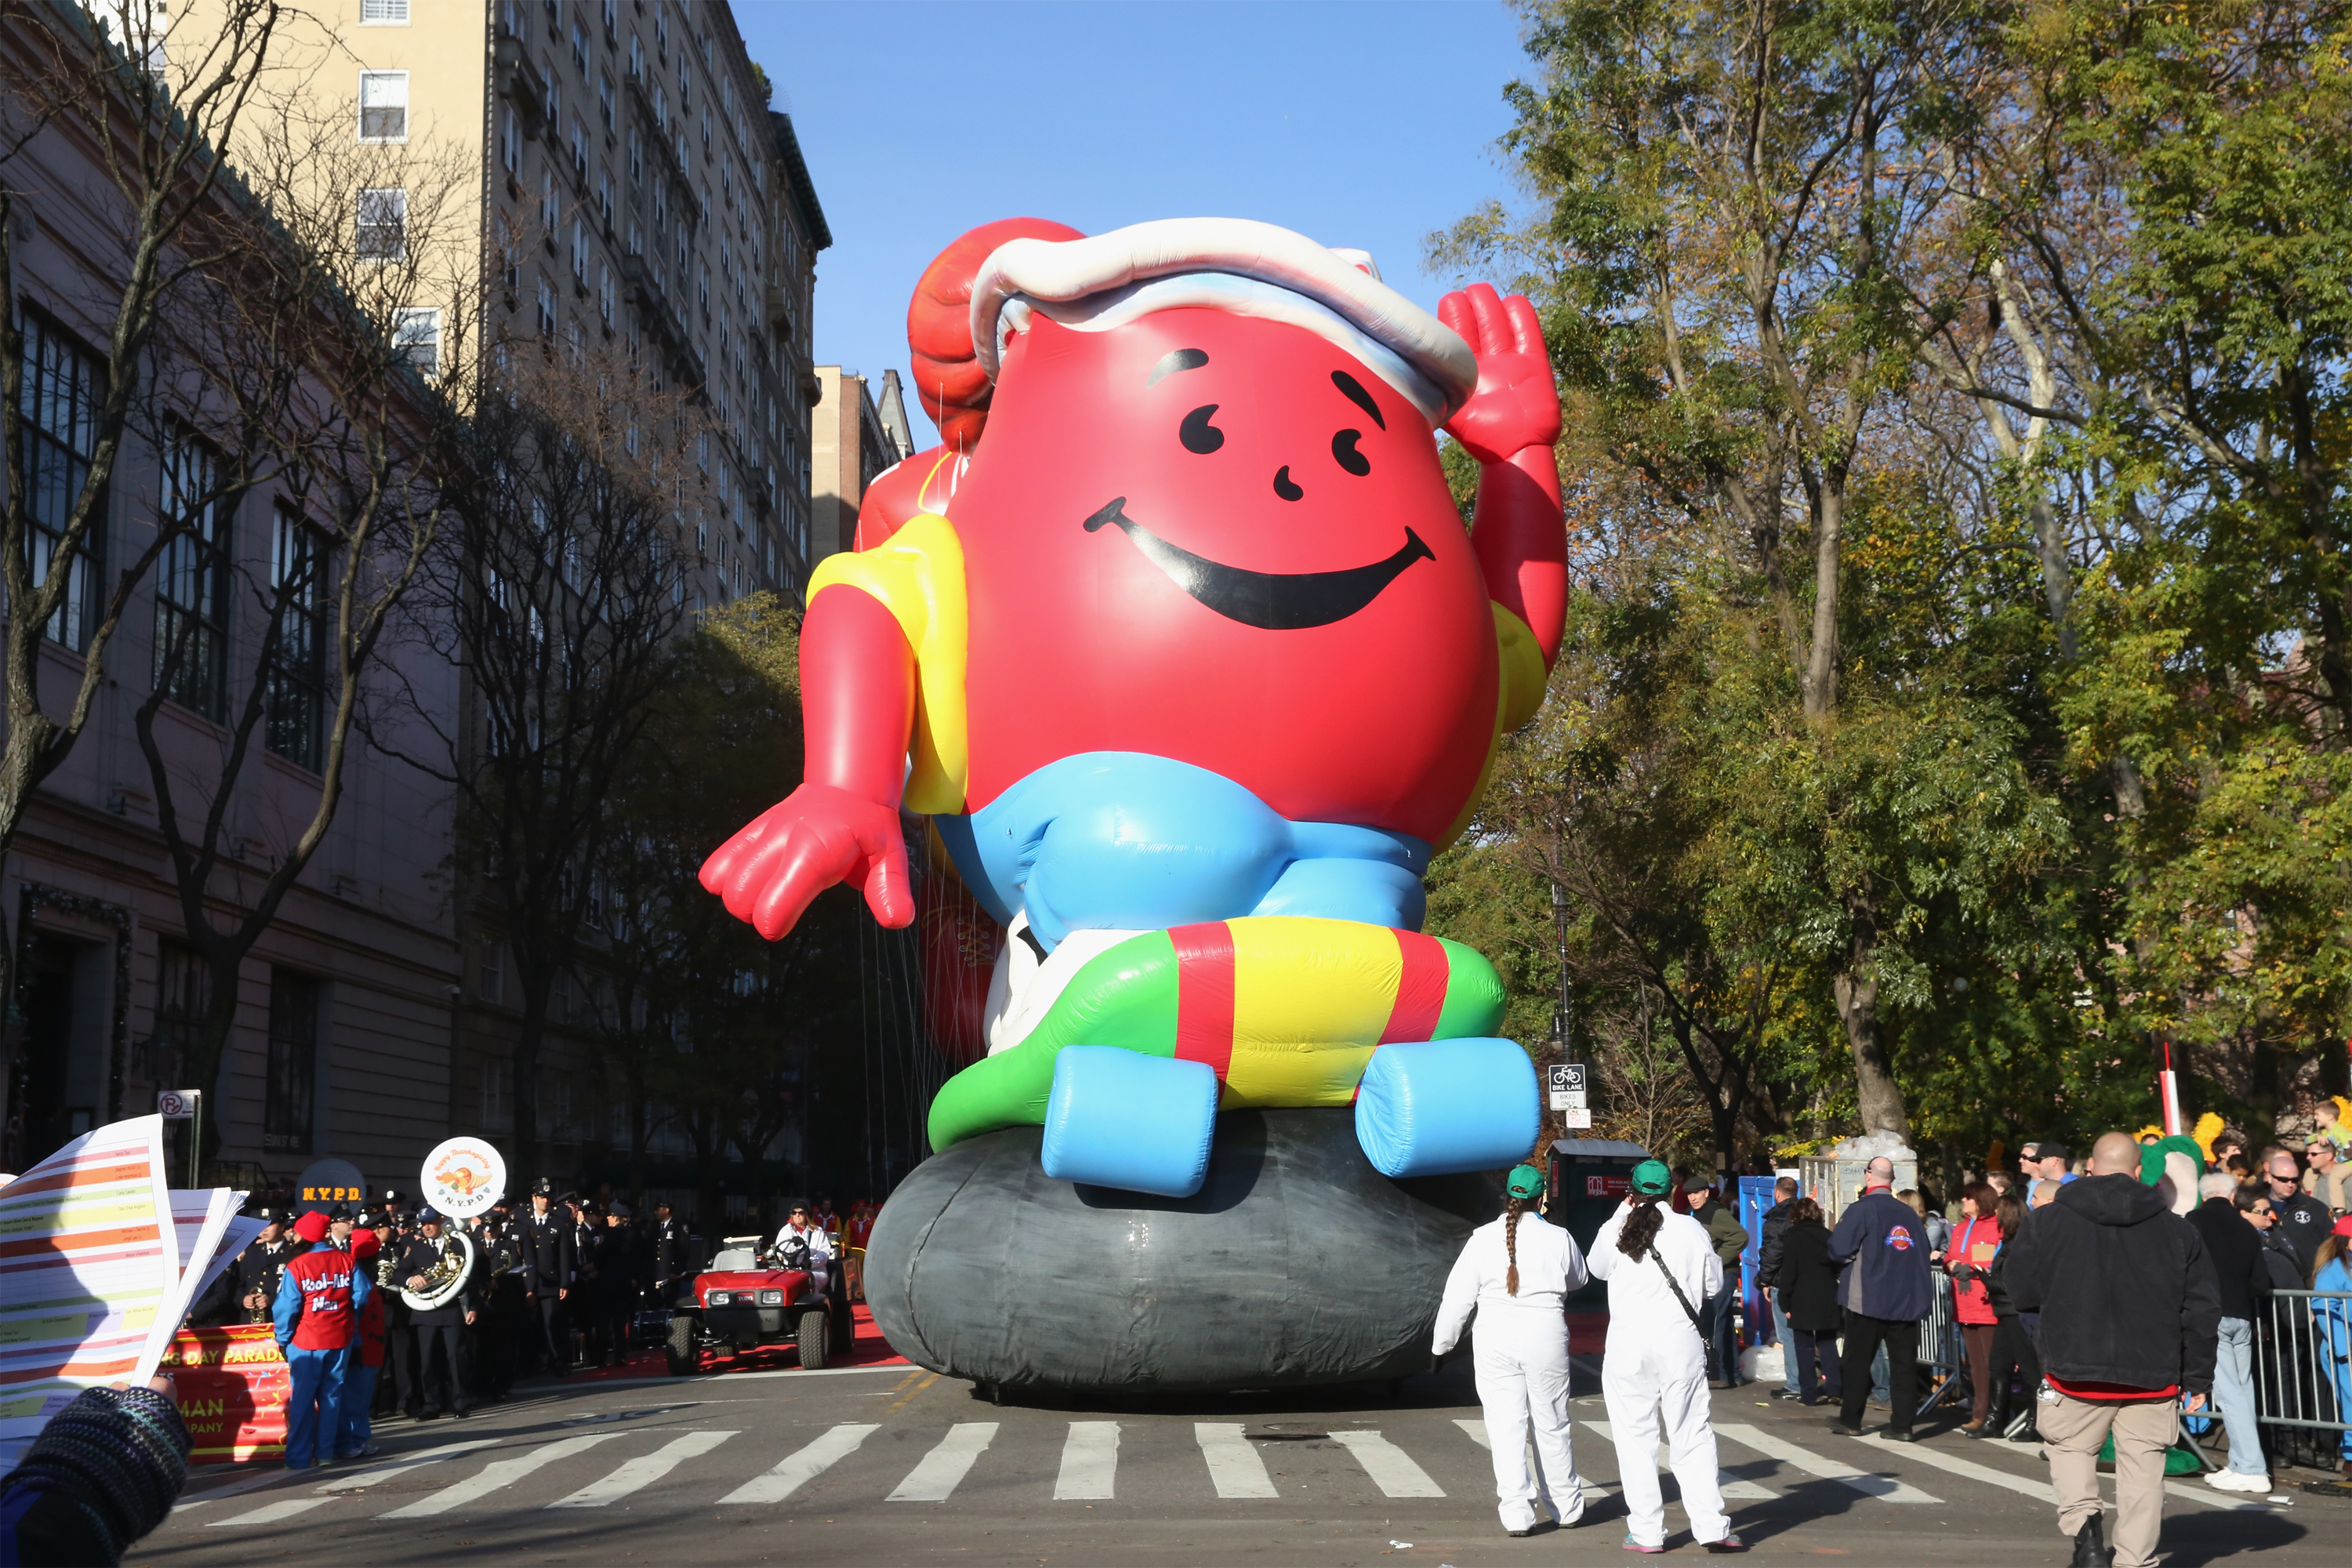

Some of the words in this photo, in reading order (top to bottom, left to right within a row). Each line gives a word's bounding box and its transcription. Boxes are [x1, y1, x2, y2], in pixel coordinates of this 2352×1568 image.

[434, 1155, 450, 1171] Happy
[450, 1149, 490, 1169] Thanksgiving
[303, 1187, 362, 1201] N.Y.P.D.
[312, 1296, 339, 1312] Man
[187, 1350, 219, 1365] DAY
[180, 1399, 223, 1417] MAN
[191, 1423, 223, 1434] PANY
